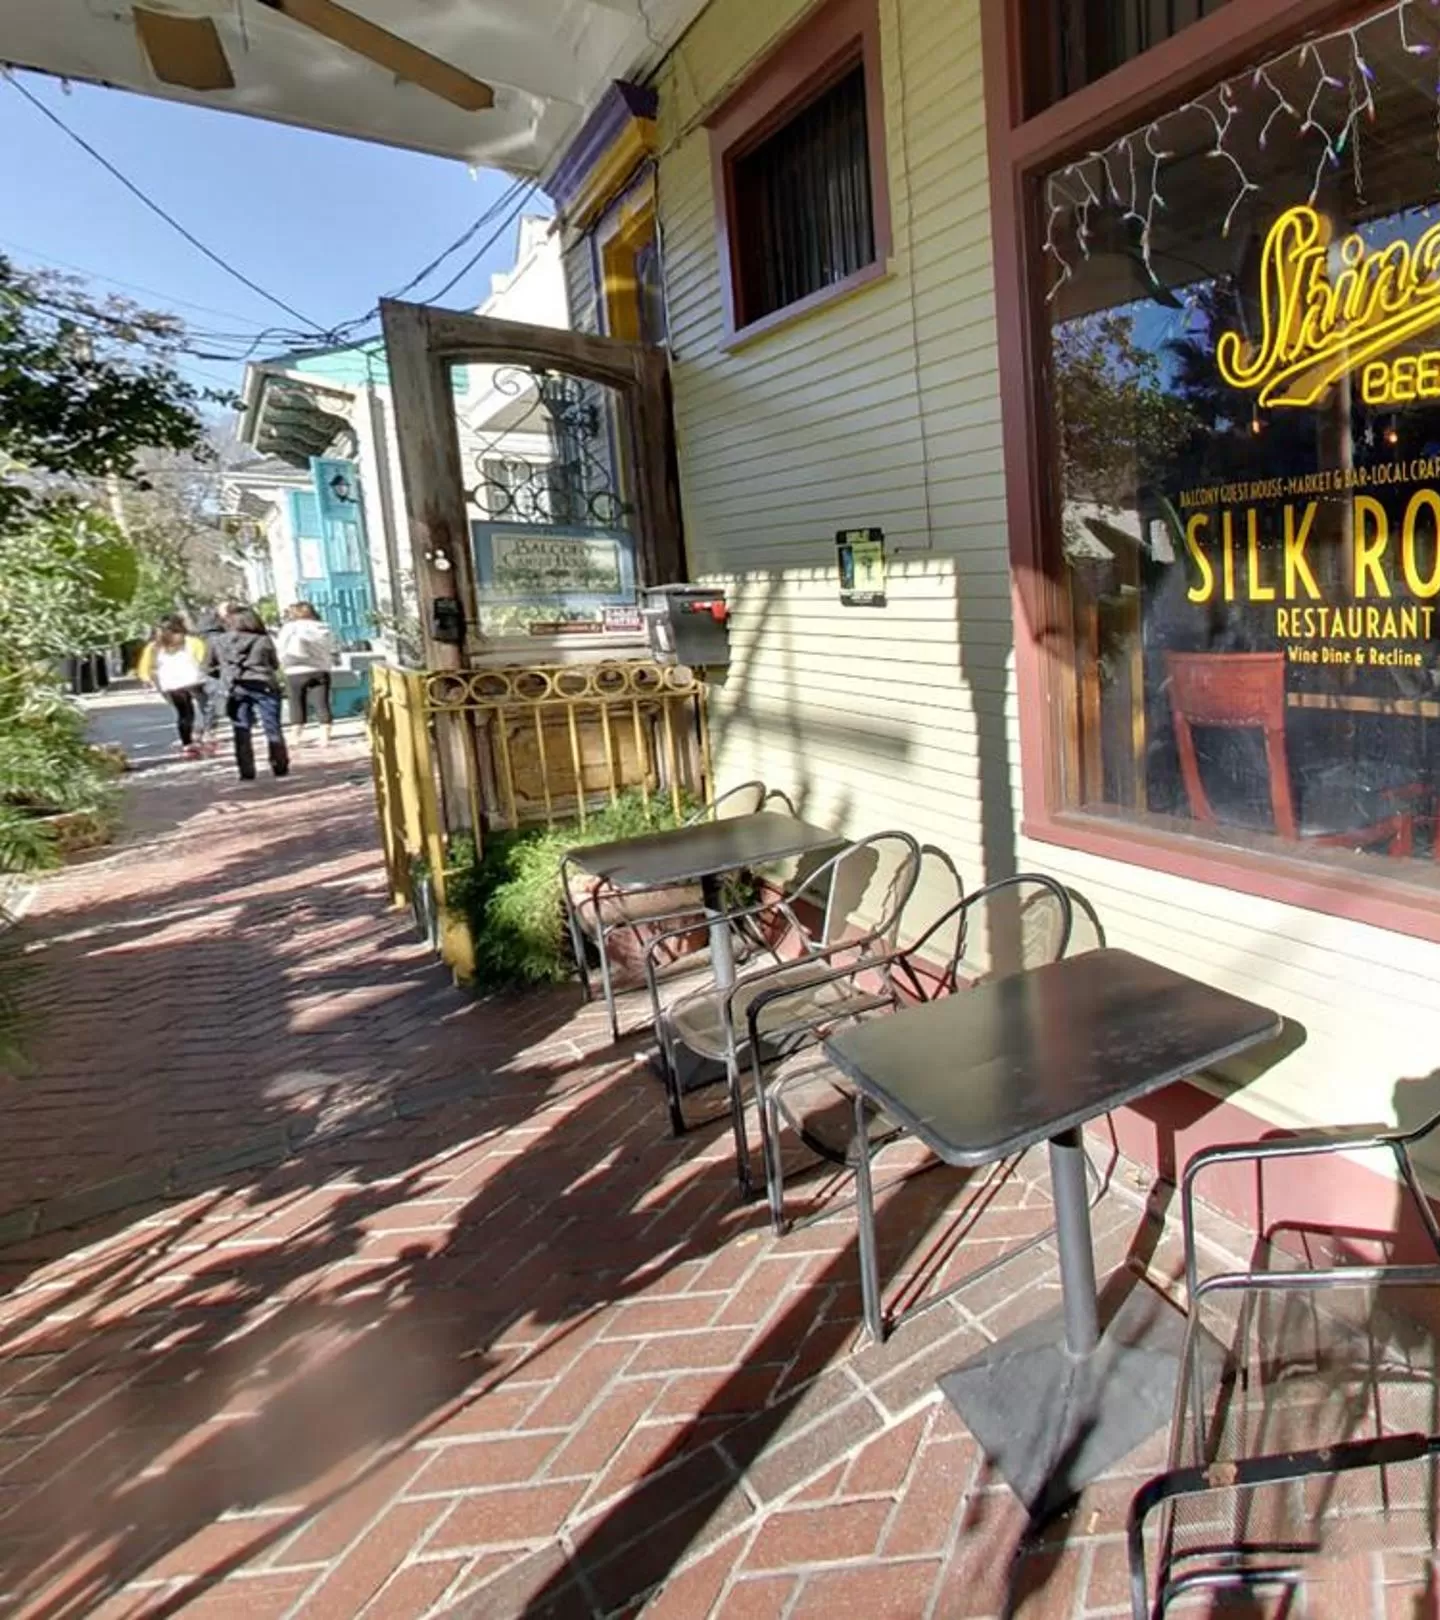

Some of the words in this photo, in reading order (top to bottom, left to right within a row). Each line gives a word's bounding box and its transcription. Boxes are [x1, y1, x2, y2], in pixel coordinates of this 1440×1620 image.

[1333, 469, 1342, 490] &
[1187, 502, 1320, 602] SILK
[1276, 606, 1435, 640] RESTAURANT
[1288, 645, 1318, 664] Wine
[1322, 646, 1351, 665] Dine
[1355, 647, 1365, 665] &
[1369, 648, 1423, 667] Recline
